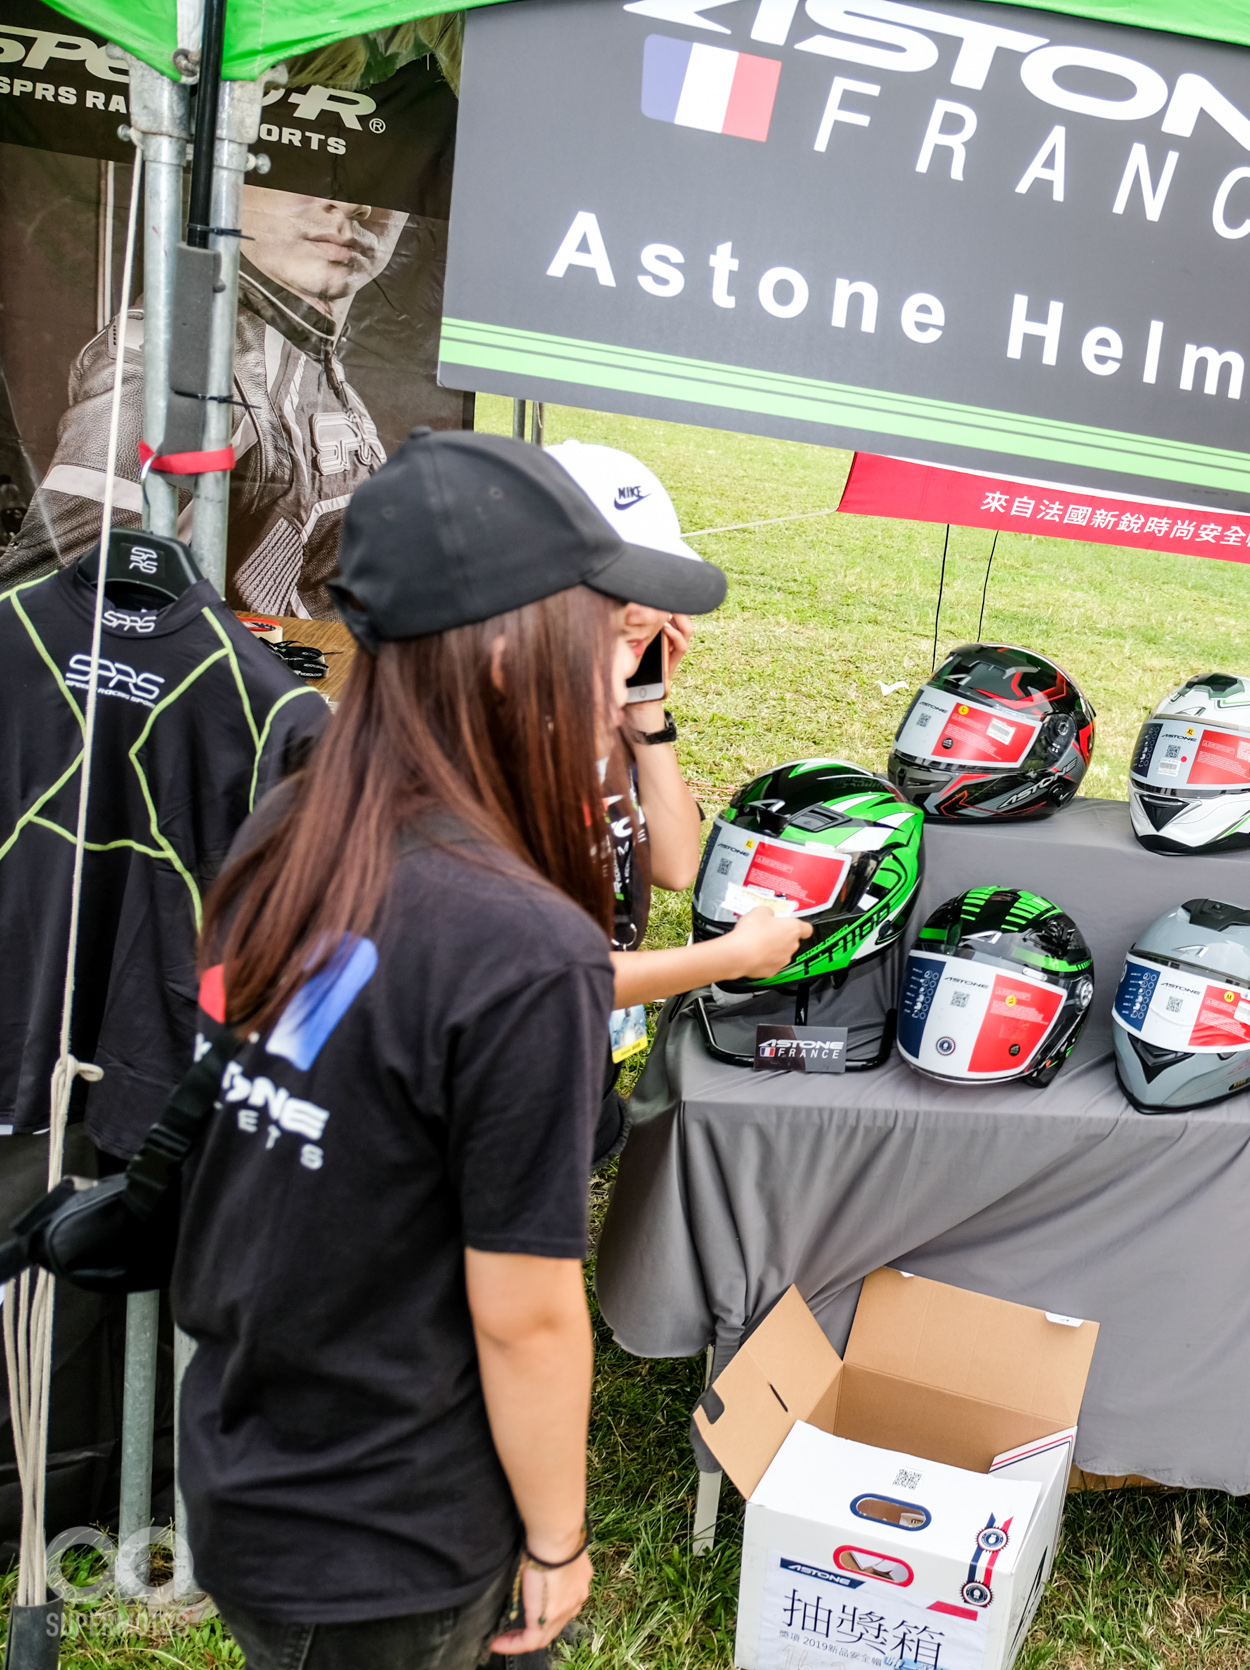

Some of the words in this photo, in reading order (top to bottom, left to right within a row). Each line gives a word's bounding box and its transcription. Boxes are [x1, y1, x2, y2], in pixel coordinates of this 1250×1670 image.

[546, 210, 947, 345] Astone
[919, 701, 948, 713] ASTONE
[1161, 733, 1198, 742] ASTONE
[998, 757, 1078, 810] ASTONE
[717, 843, 750, 858] ASTONE
[943, 976, 989, 990] ASTONE
[1160, 982, 1201, 996] ASTONE
[758, 1038, 845, 1050] ASTONE
[777, 1047, 840, 1060] FRANCE
[787, 1564, 851, 1586] ASTONE
[783, 1588, 946, 1669] 抽獎箱
